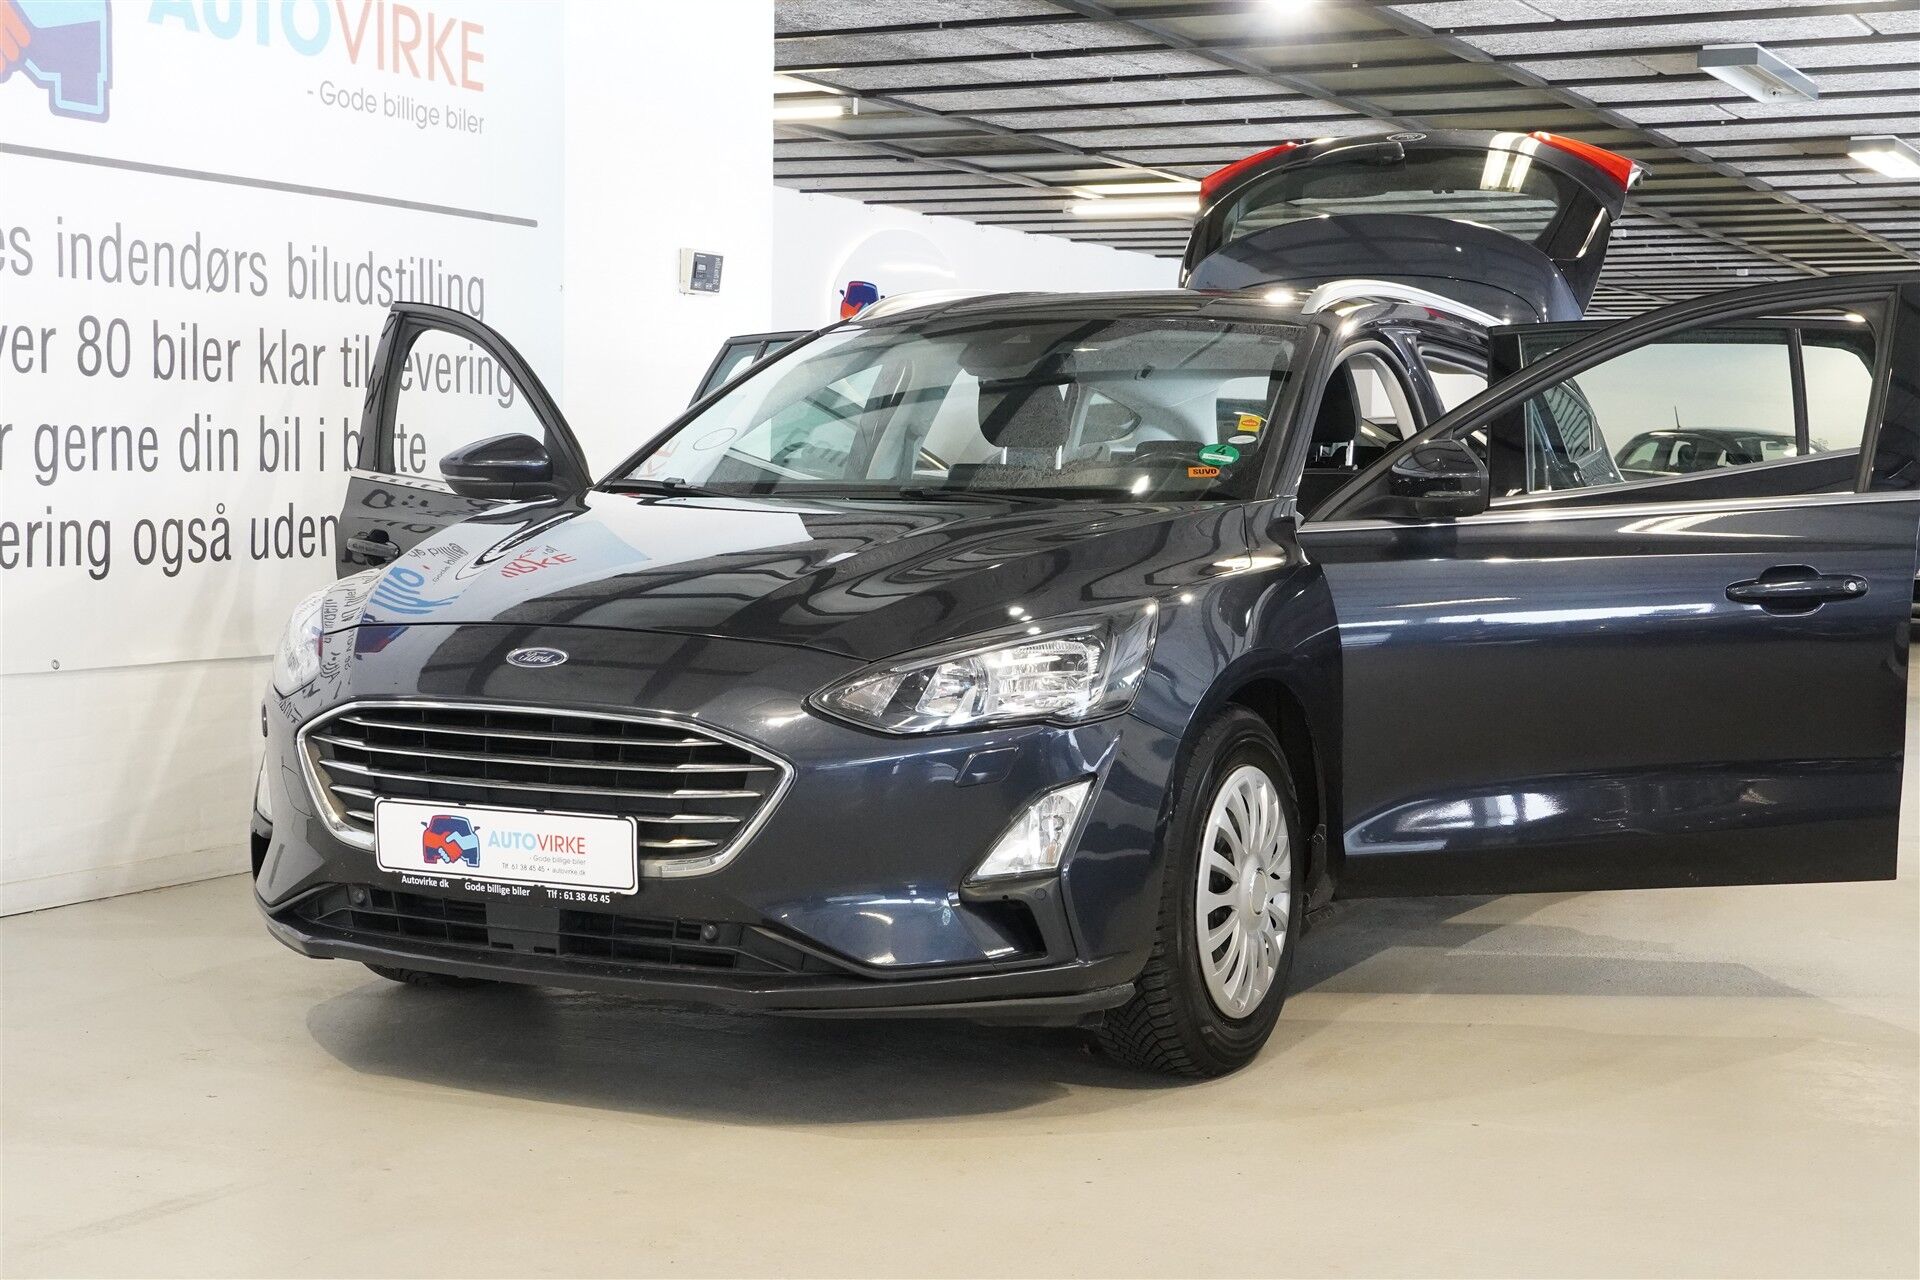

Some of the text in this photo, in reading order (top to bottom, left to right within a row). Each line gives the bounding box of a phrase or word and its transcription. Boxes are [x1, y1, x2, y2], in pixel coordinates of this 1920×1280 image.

[319, 80, 377, 113] Gode
[383, 92, 440, 130] billige
[446, 105, 485, 134] biler
[0, 216, 485, 322] s indendørs biludstilling
[77, 315, 131, 381] 80
[152, 320, 241, 383] biler
[258, 327, 326, 388] klar
[340, 333, 370, 389] til
[397, 342, 515, 409] evering
[34, 420, 158, 487] gerne
[179, 414, 239, 472] din
[259, 416, 301, 473] bil
[319, 417, 326, 472] i
[133, 503, 233, 578] også
[250, 503, 341, 561] uden
[488, 830, 586, 855] AUTOVIRKE
[533, 855, 551, 863] Gode
[553, 857, 571, 866] billige
[401, 875, 449, 888] Autovirke dk
[464, 881, 531, 896] Gode billige biler
[564, 891, 574, 900] 61
[576, 892, 586, 902] 38
[588, 893, 598, 903] 45
[600, 894, 611, 904] 45
